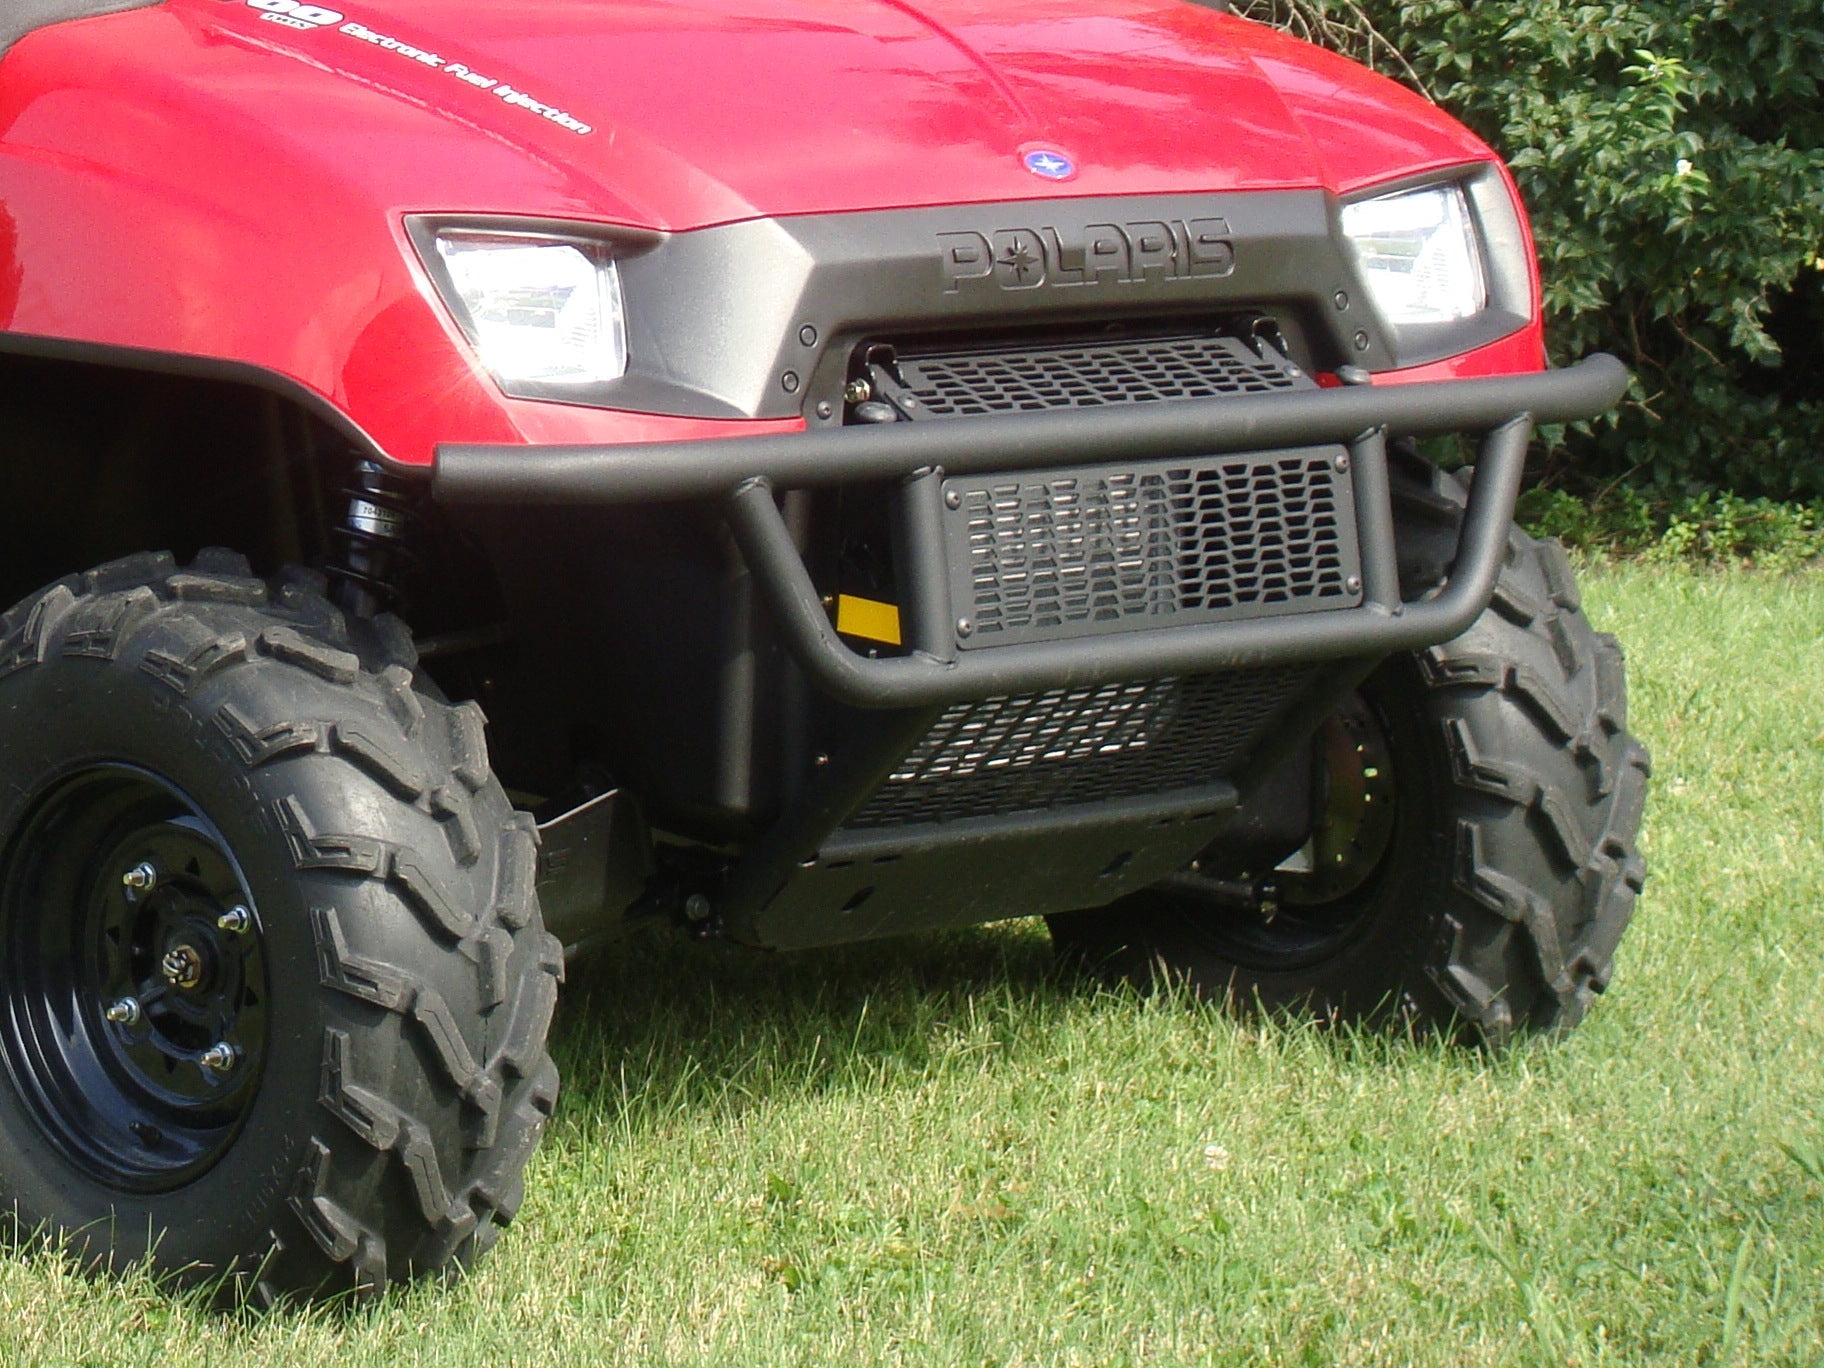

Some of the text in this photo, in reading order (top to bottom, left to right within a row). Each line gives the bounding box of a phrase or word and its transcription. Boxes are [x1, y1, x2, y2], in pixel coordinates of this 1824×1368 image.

[338, 22, 446, 68] Electronic
[443, 63, 498, 89] Fuel
[492, 84, 592, 134] Injection
[936, 217, 1235, 294] POLARIS
